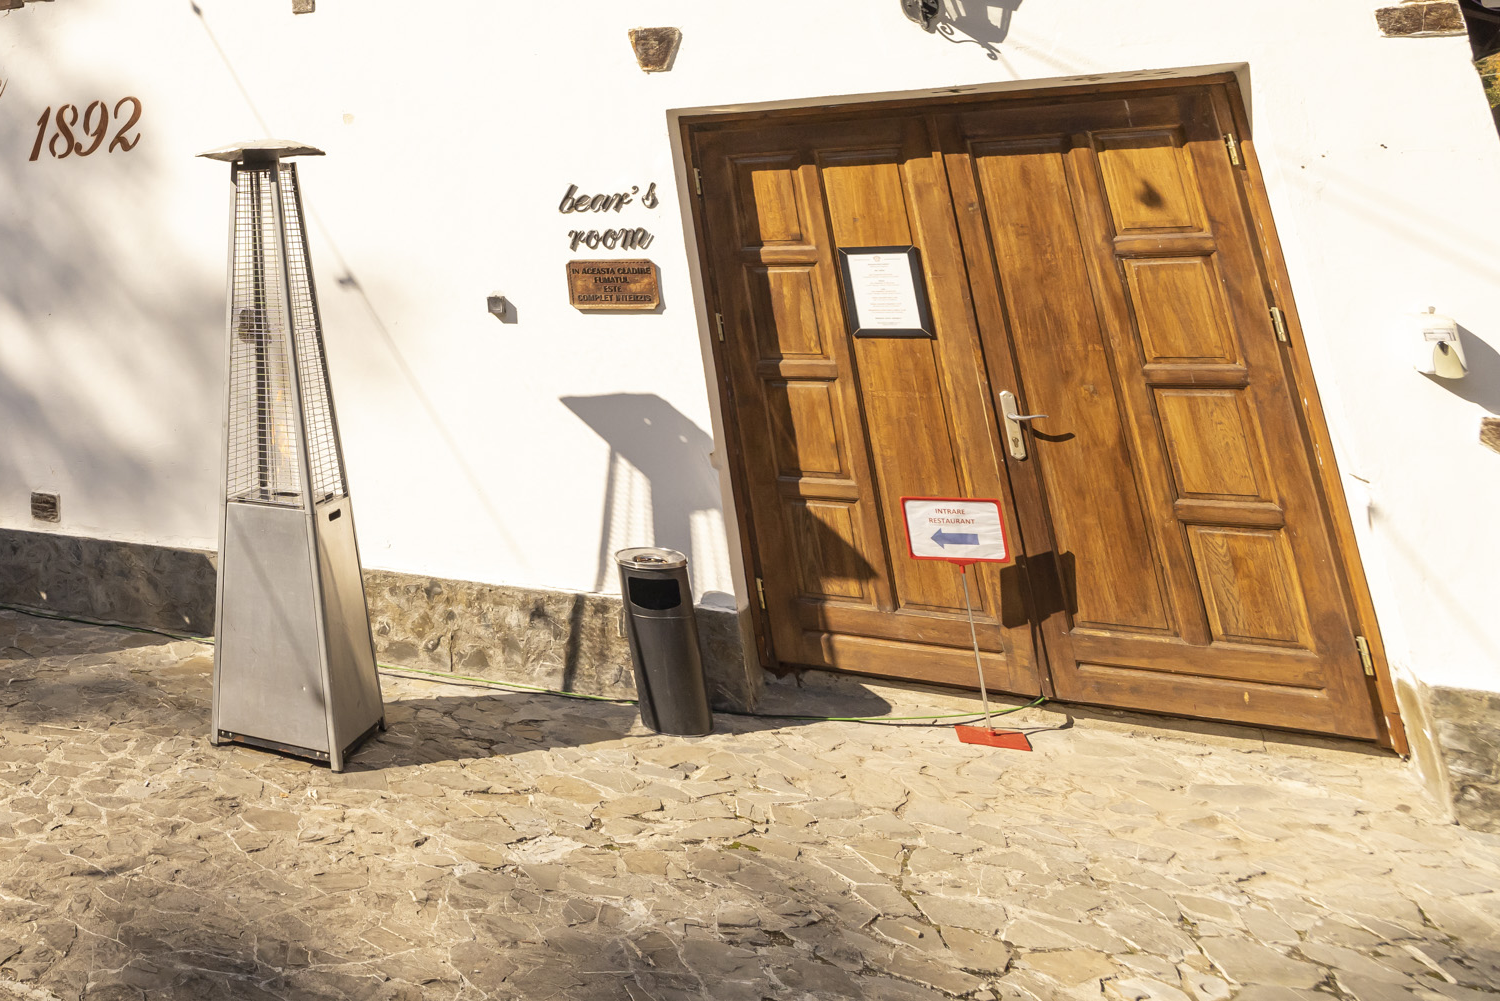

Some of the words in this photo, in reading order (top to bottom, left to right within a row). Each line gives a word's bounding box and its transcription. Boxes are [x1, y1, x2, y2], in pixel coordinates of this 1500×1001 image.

[29, 96, 142, 162] 1892
[559, 182, 659, 214] bear's
[567, 226, 655, 253] room
[594, 276, 629, 284] FUMATUL
[603, 285, 622, 293] ESTE
[578, 294, 613, 302] COMPLET
[928, 517, 975, 525] RESTAURANT
